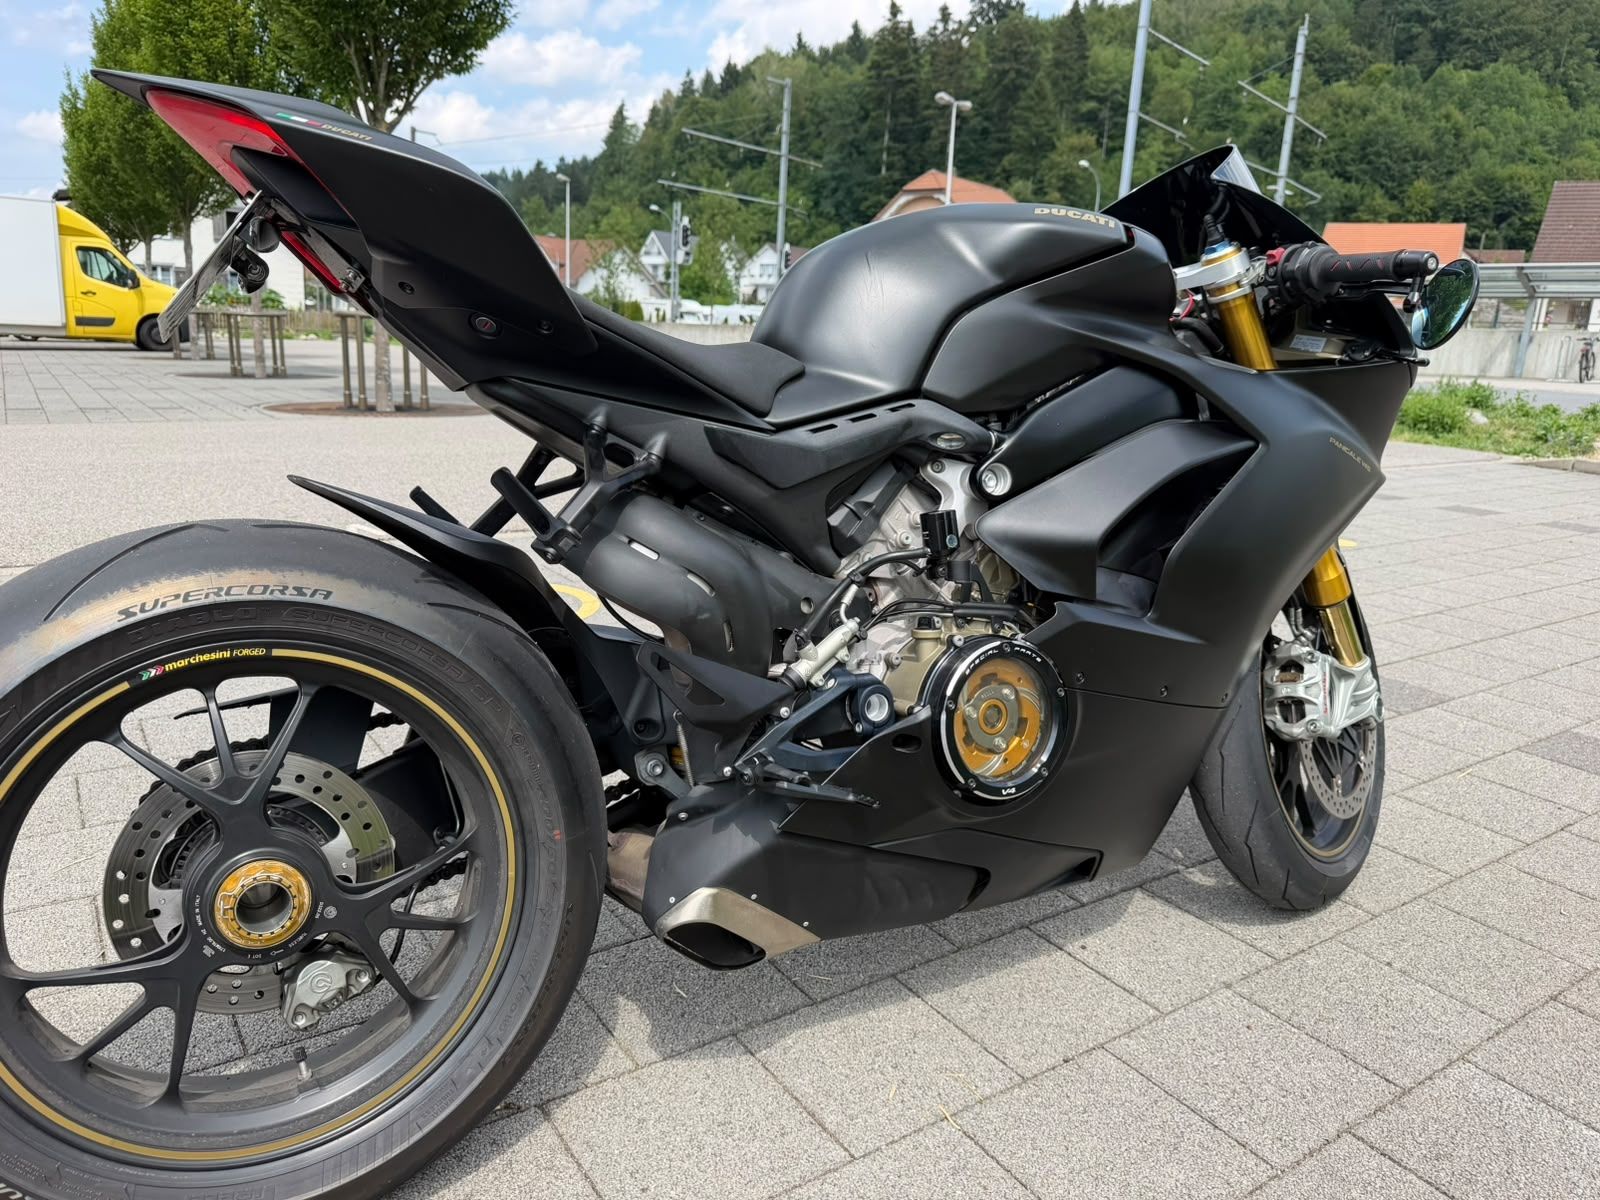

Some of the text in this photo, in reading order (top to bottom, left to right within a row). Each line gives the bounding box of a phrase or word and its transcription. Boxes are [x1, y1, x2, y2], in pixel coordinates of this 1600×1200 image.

[321, 124, 373, 141] DUCATI
[1034, 207, 1115, 228] DUCATI
[117, 584, 334, 622] SUPERCORSA
[294, 608, 464, 680] SUPERCORSA
[165, 647, 266, 671] marchesini FORGED
[965, 646, 1042, 675] SPECIAL PARTS
